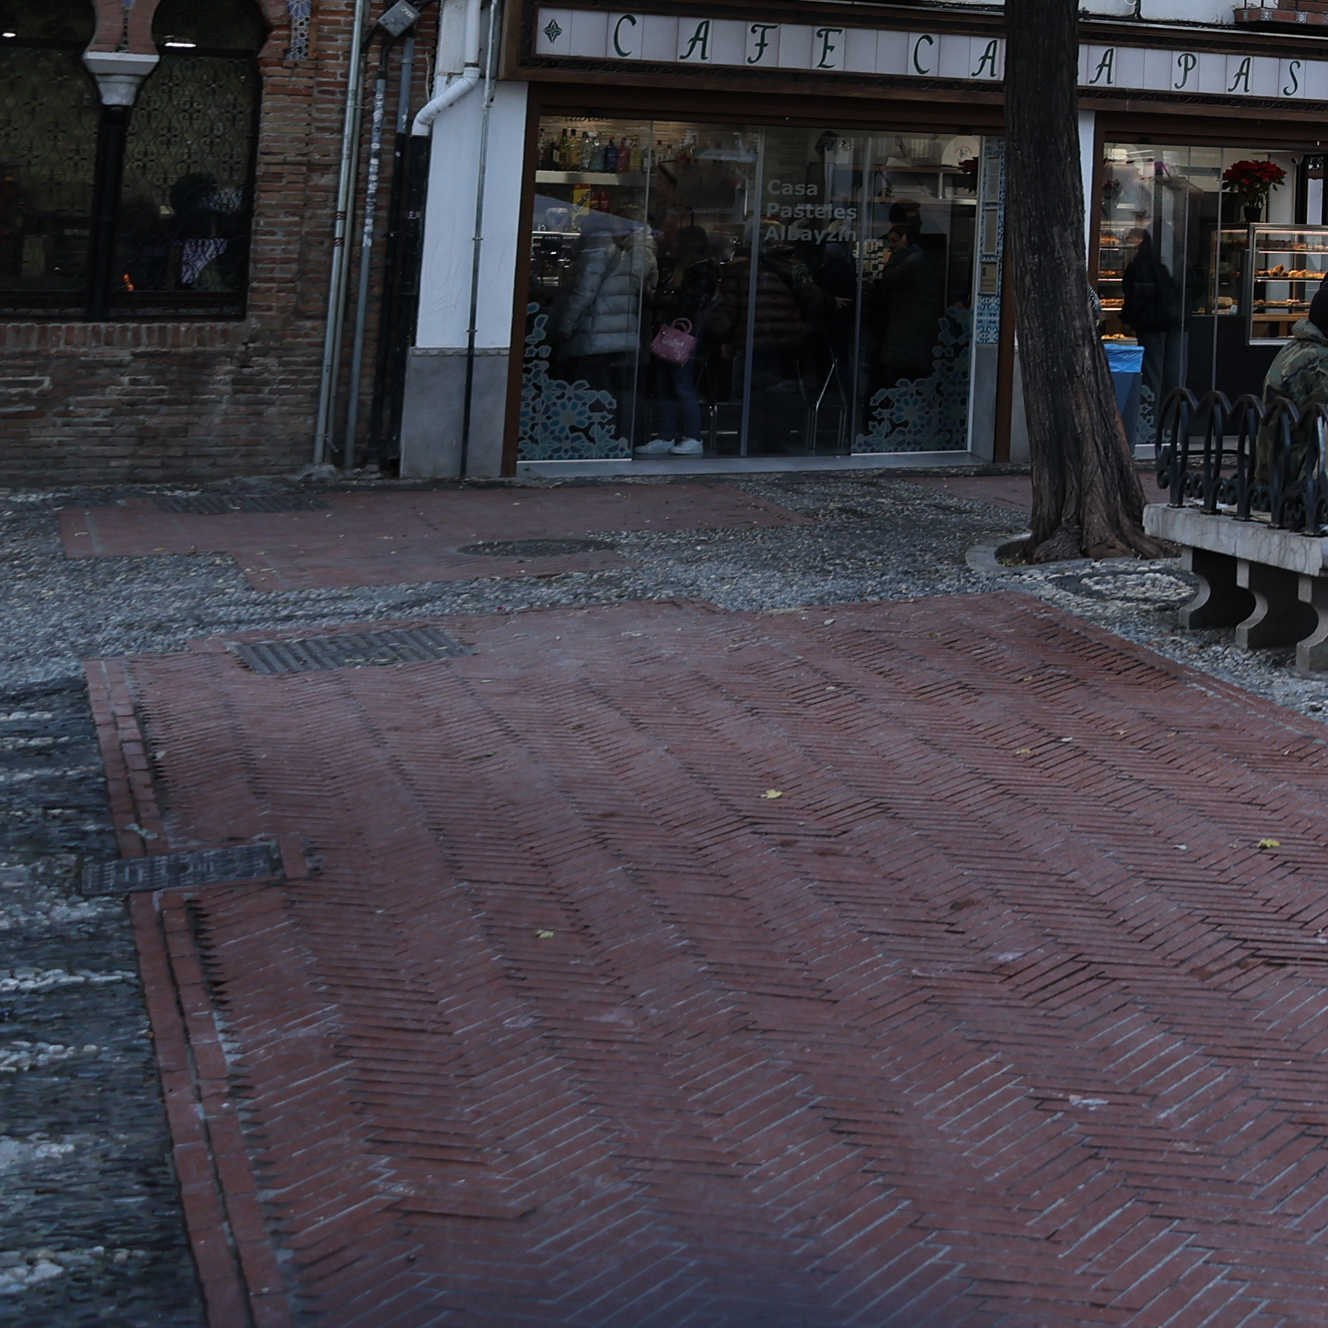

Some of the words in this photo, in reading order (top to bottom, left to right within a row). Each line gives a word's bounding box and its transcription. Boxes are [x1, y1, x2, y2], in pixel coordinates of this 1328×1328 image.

[613, 14, 843, 69] CAFE
[913, 34, 1115, 85] CAA
[767, 179, 819, 196] Casa
[766, 202, 858, 220] Pasteles
